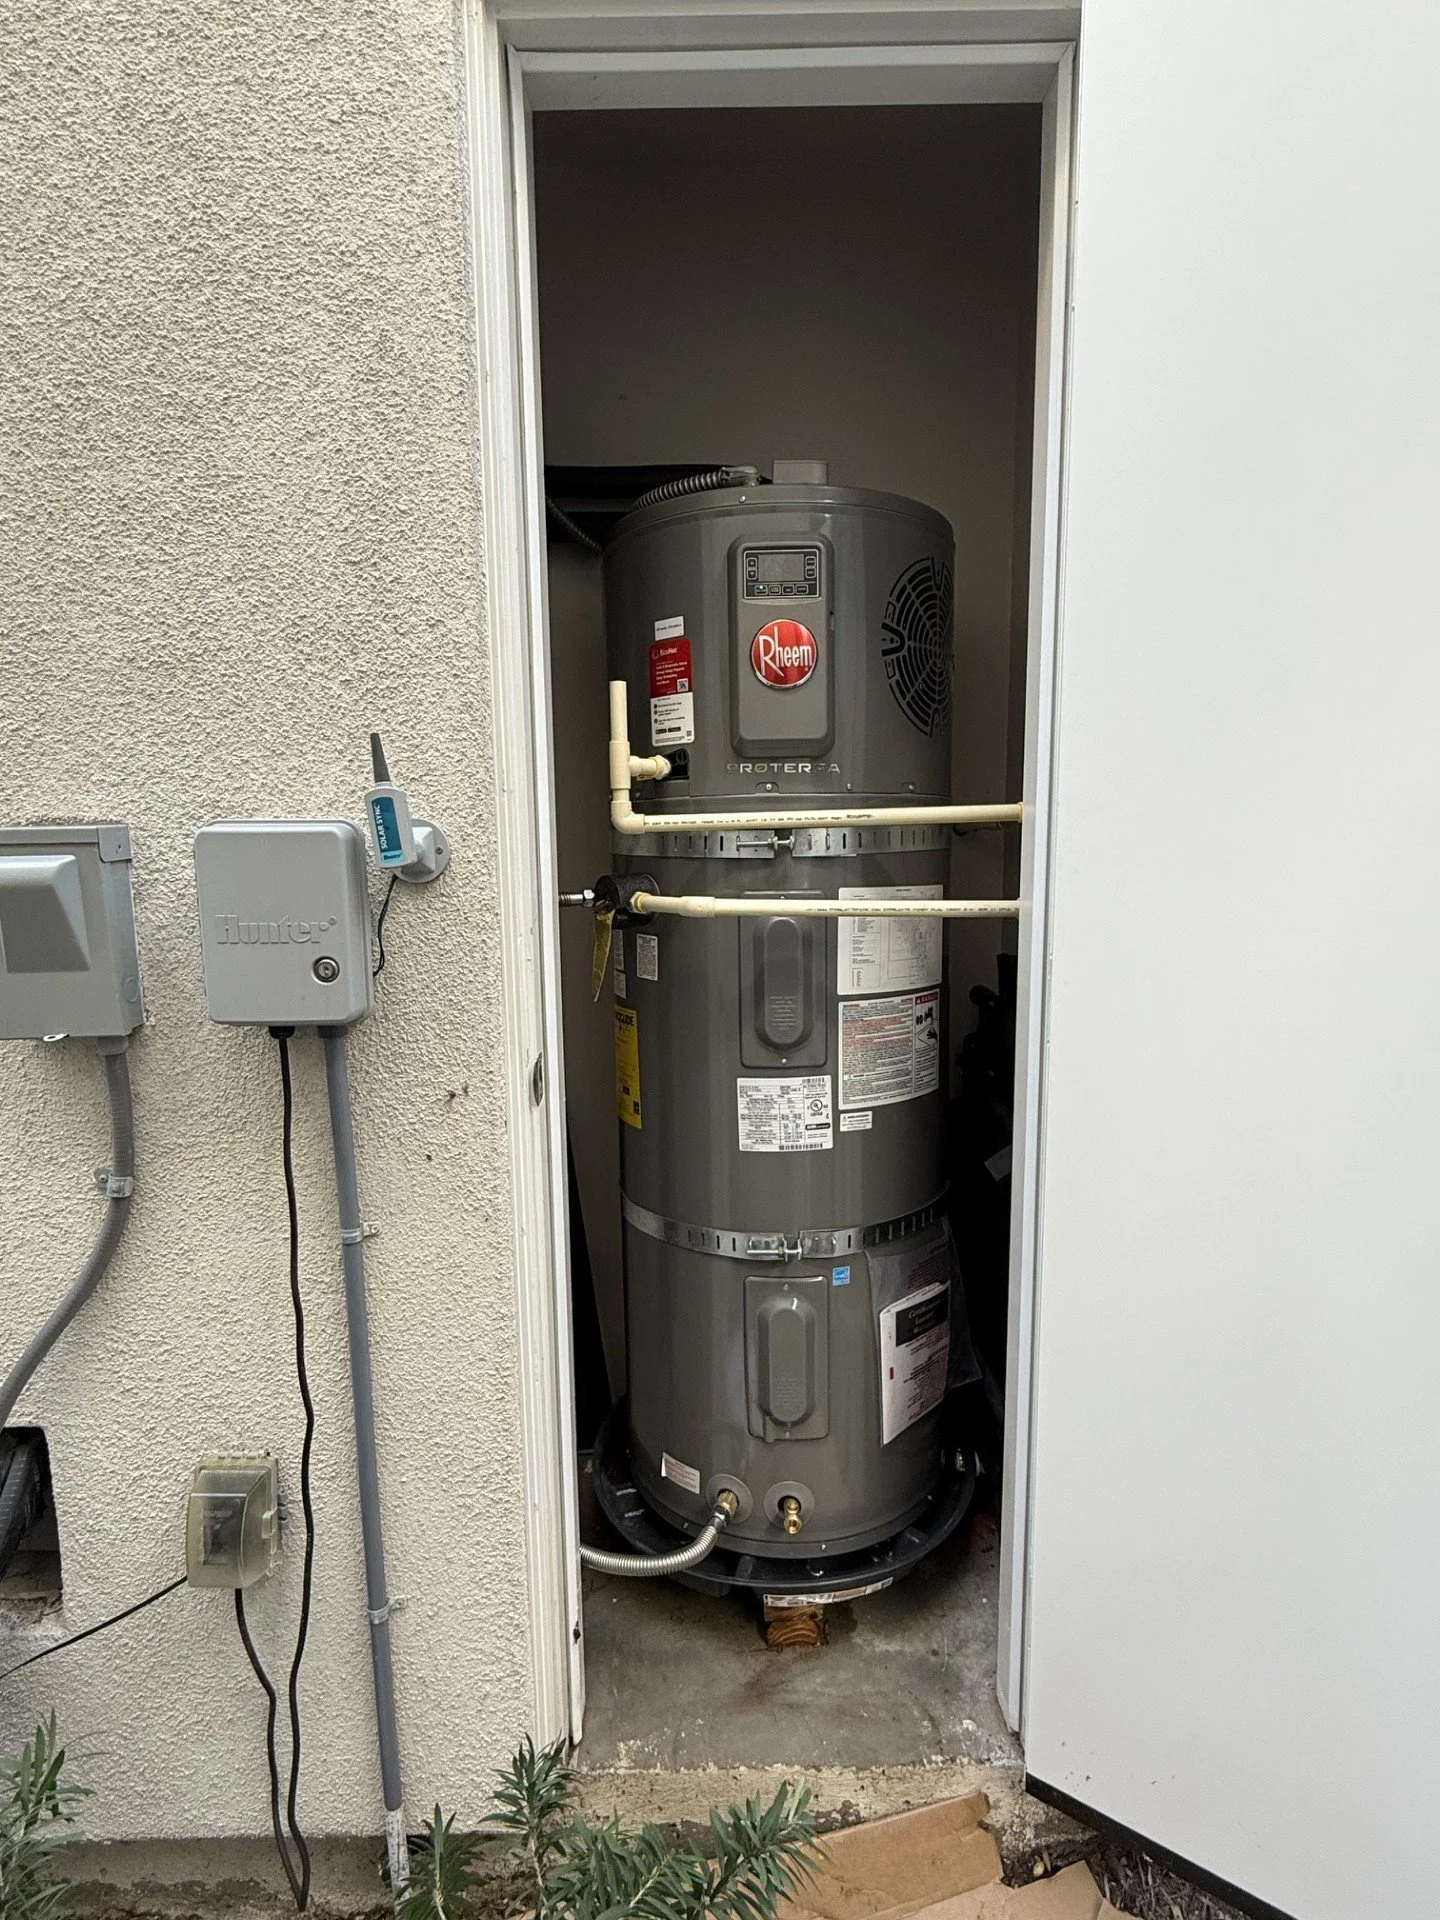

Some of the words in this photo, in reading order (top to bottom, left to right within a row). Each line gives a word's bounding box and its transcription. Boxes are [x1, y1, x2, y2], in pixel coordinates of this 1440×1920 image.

[759, 626, 812, 677] Rheem
[374, 802, 384, 824] SYNC
[378, 825, 388, 849] SOLAR
